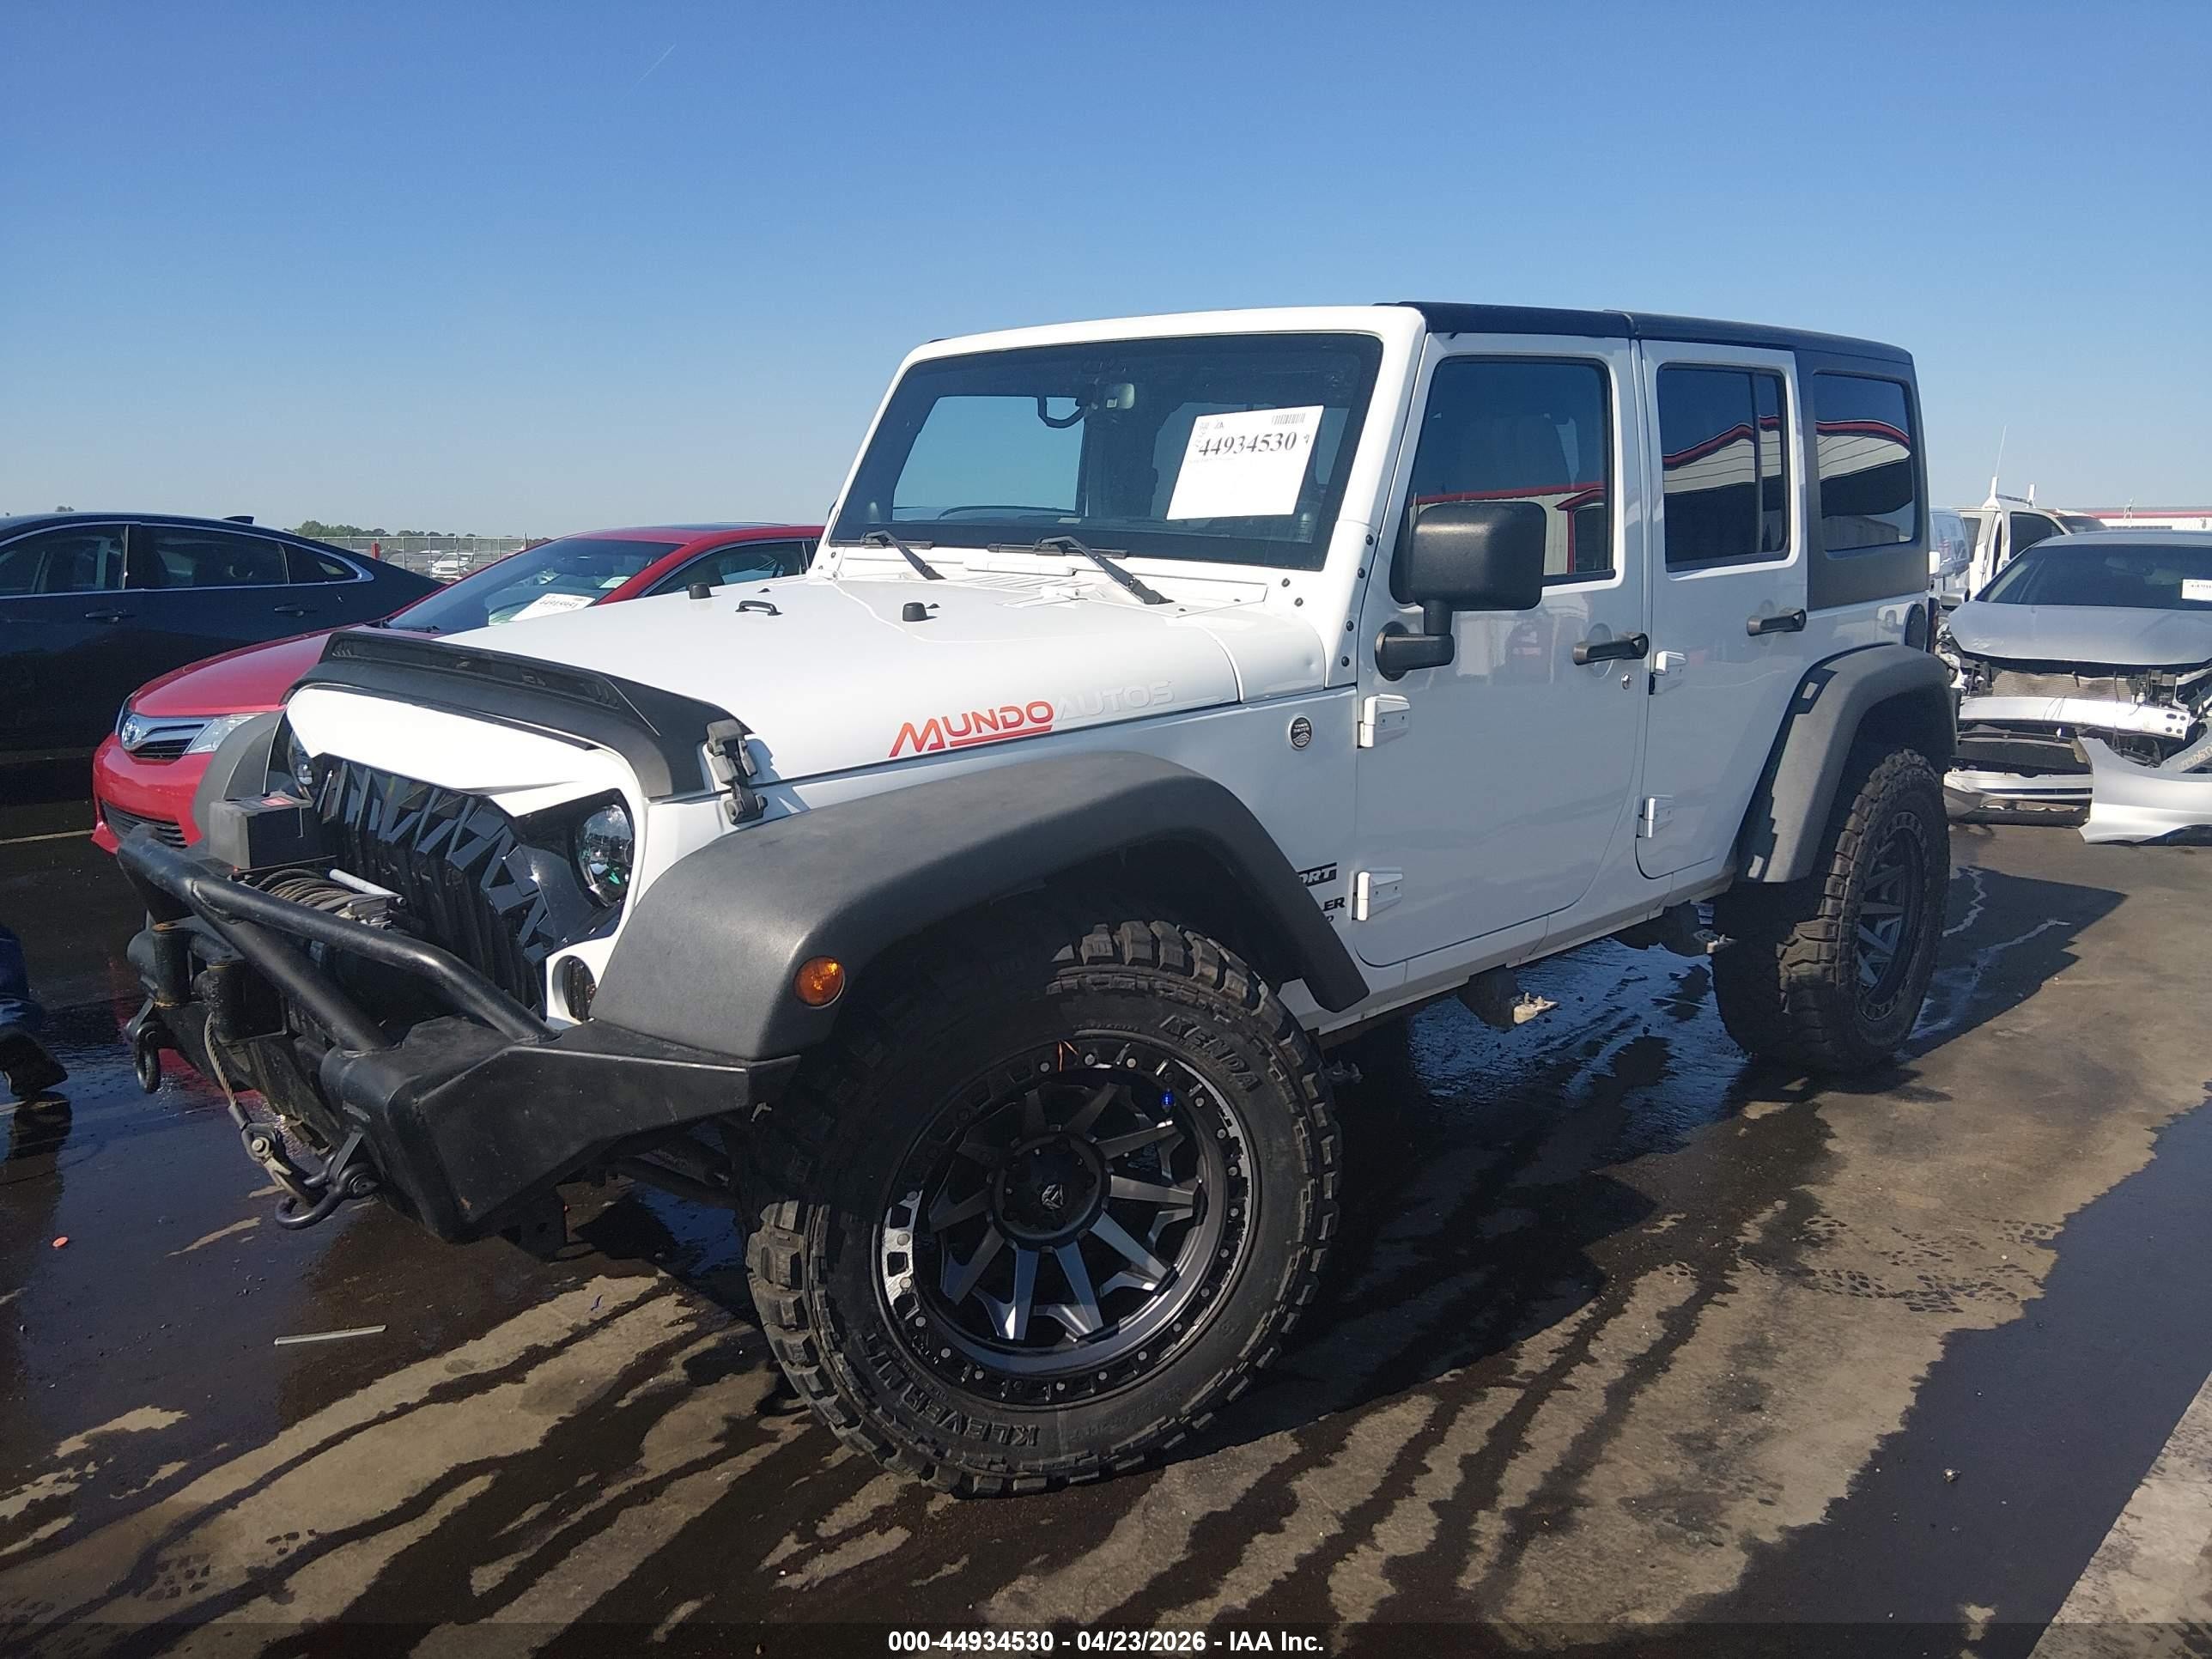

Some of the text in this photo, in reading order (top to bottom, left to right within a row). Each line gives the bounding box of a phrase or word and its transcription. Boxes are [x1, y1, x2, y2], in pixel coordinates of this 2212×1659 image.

[1199, 431, 1297, 456] 44934530
[888, 679, 1176, 757] MUNDO AUTOS
[1158, 1014, 1263, 1093] KENDA
[900, 1382, 1040, 1449] KLEVER
